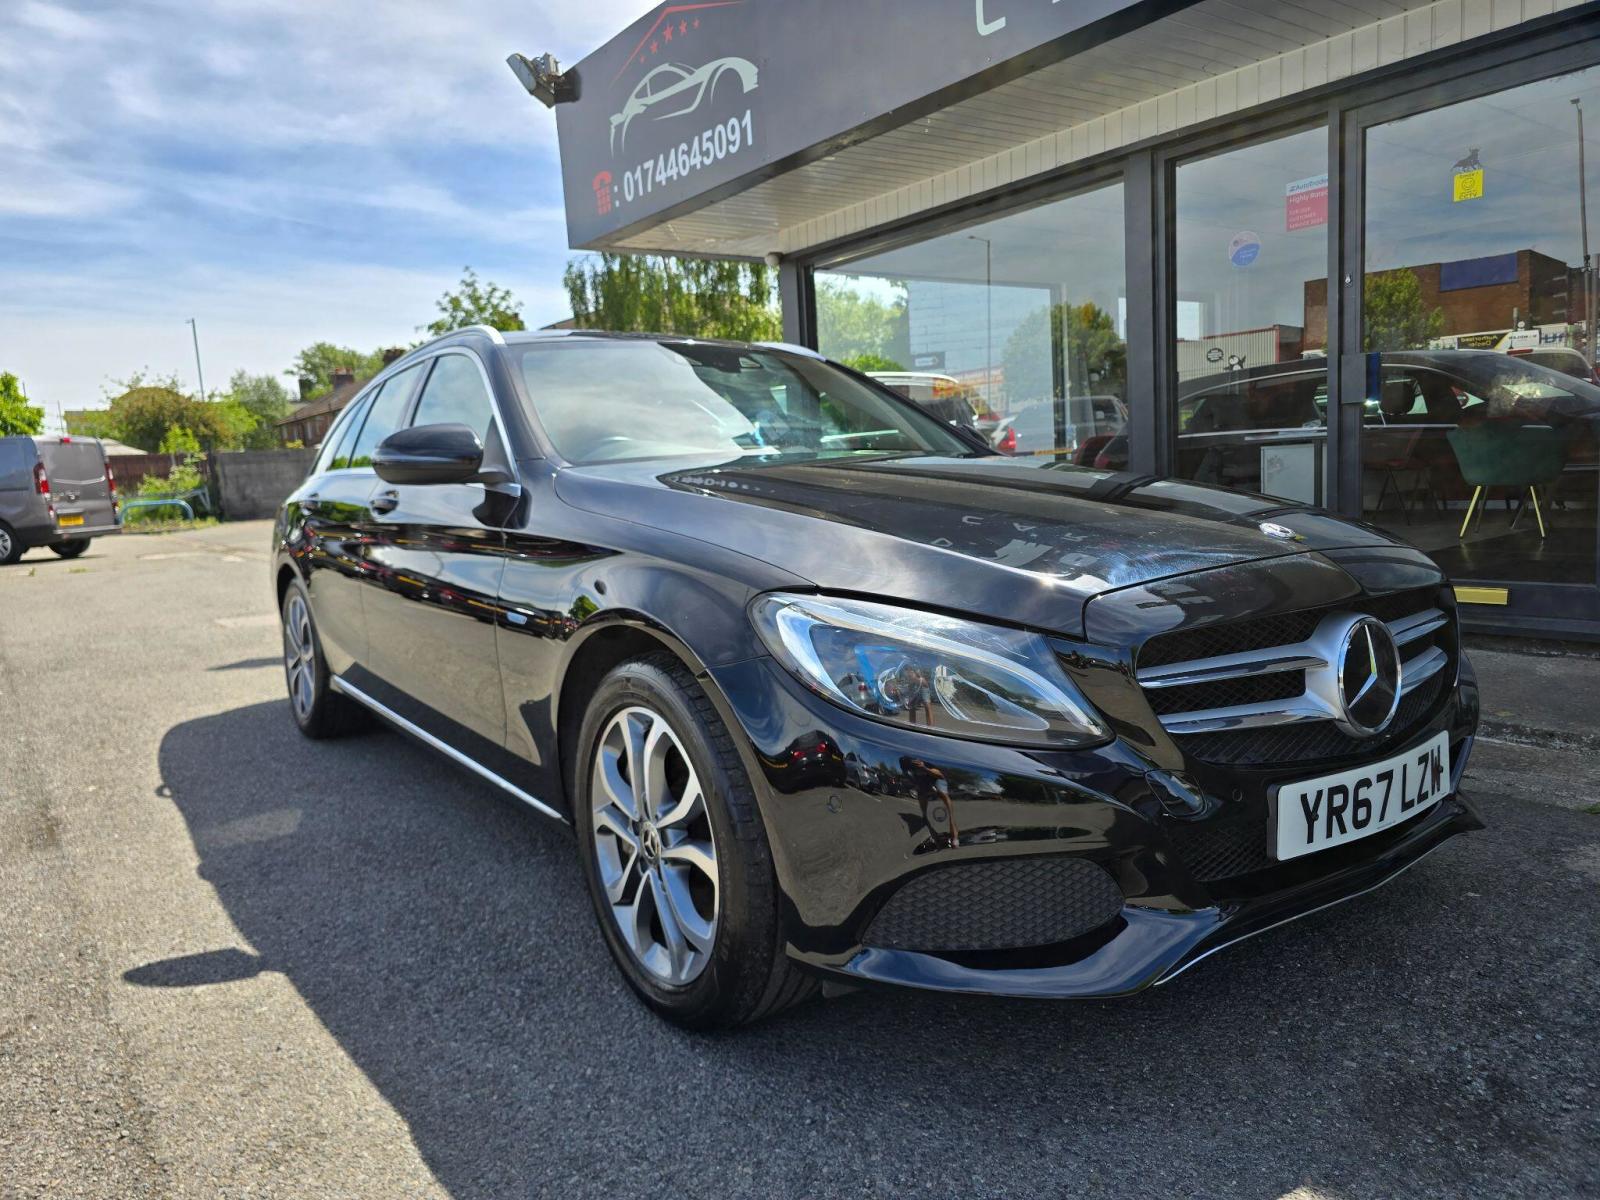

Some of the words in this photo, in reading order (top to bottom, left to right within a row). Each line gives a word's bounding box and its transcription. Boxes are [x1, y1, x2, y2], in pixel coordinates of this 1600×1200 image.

[623, 109, 754, 203] 01744645091
[1300, 768, 1394, 845] YR67
[1400, 744, 1442, 814] LZW
